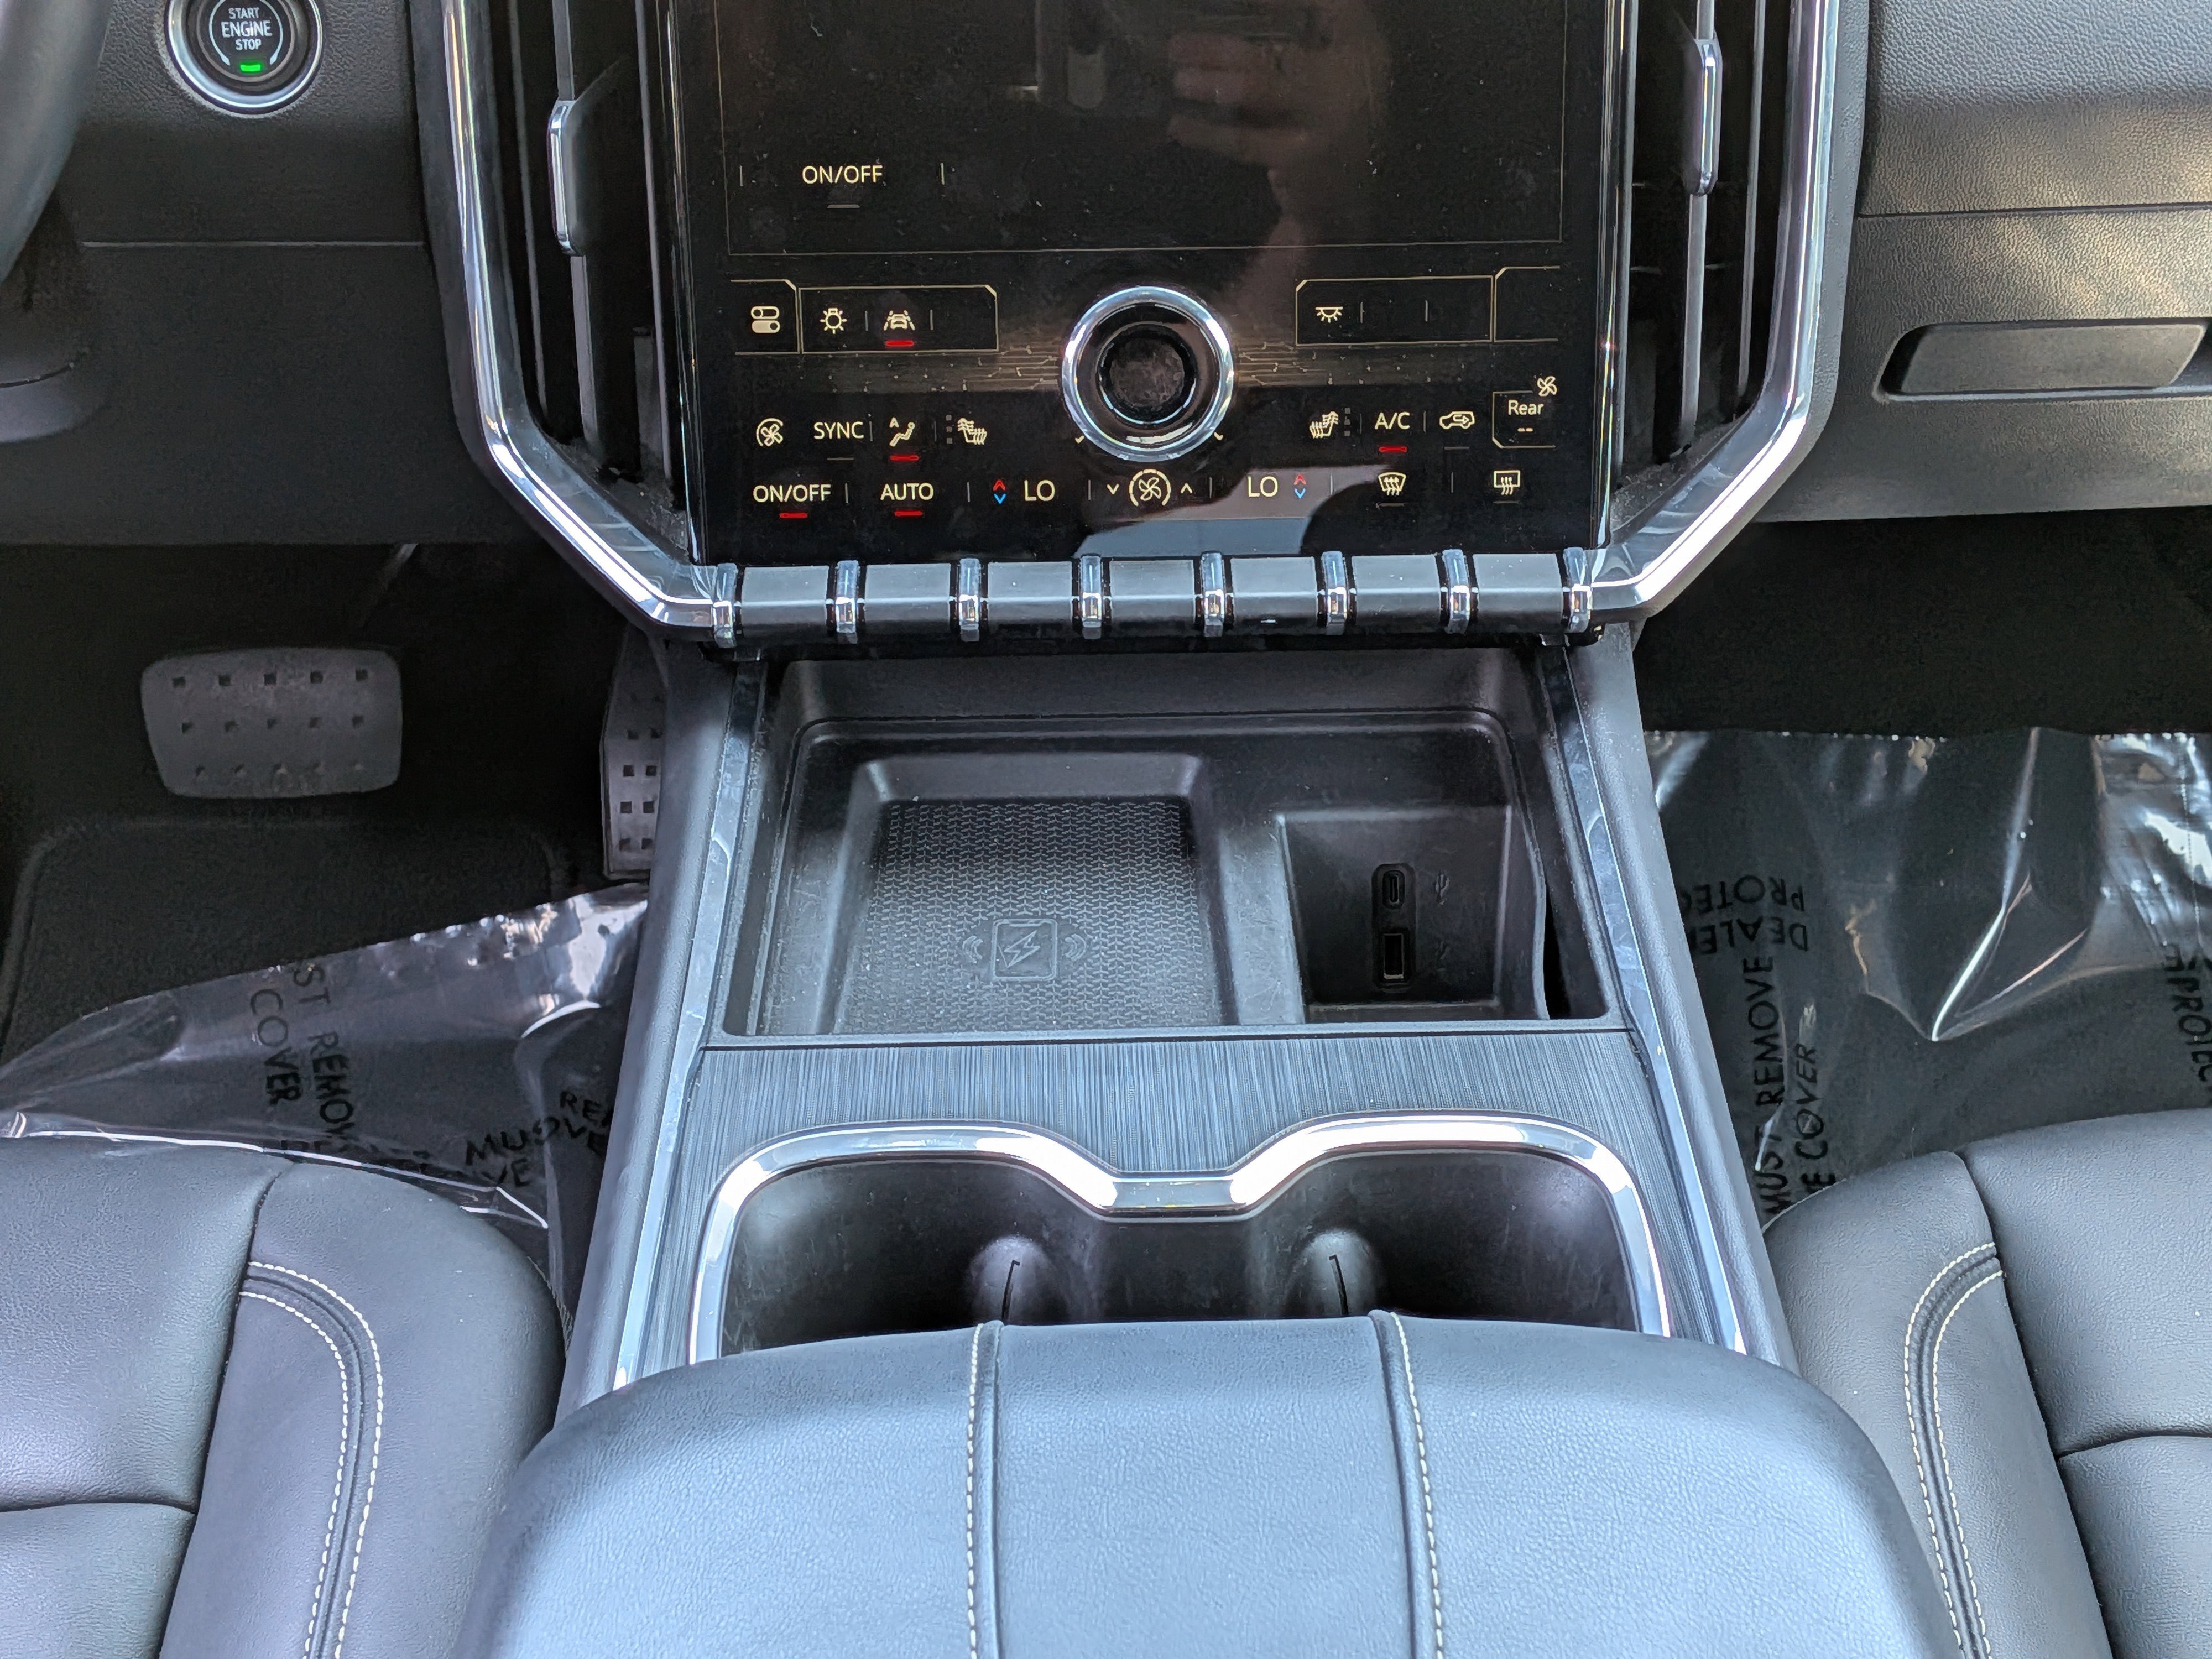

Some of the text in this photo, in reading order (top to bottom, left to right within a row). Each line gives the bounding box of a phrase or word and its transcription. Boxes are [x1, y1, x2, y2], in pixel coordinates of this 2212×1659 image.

[228, 7, 260, 19] START
[221, 20, 273, 38] ENGINE
[235, 38, 262, 51] STOP
[802, 165, 883, 184] ON/OFF
[1508, 399, 1545, 416] Rear
[1374, 411, 1411, 430] A/C
[813, 421, 865, 440] SYNC
[753, 483, 832, 503] ON/OFF
[880, 482, 935, 501] AUTO
[1024, 479, 1056, 502] LO
[1248, 476, 1279, 498] LO
[1742, 957, 1785, 1105] REMOVE
[250, 988, 302, 1105] COVER
[1794, 1043, 1828, 1160] COVER
